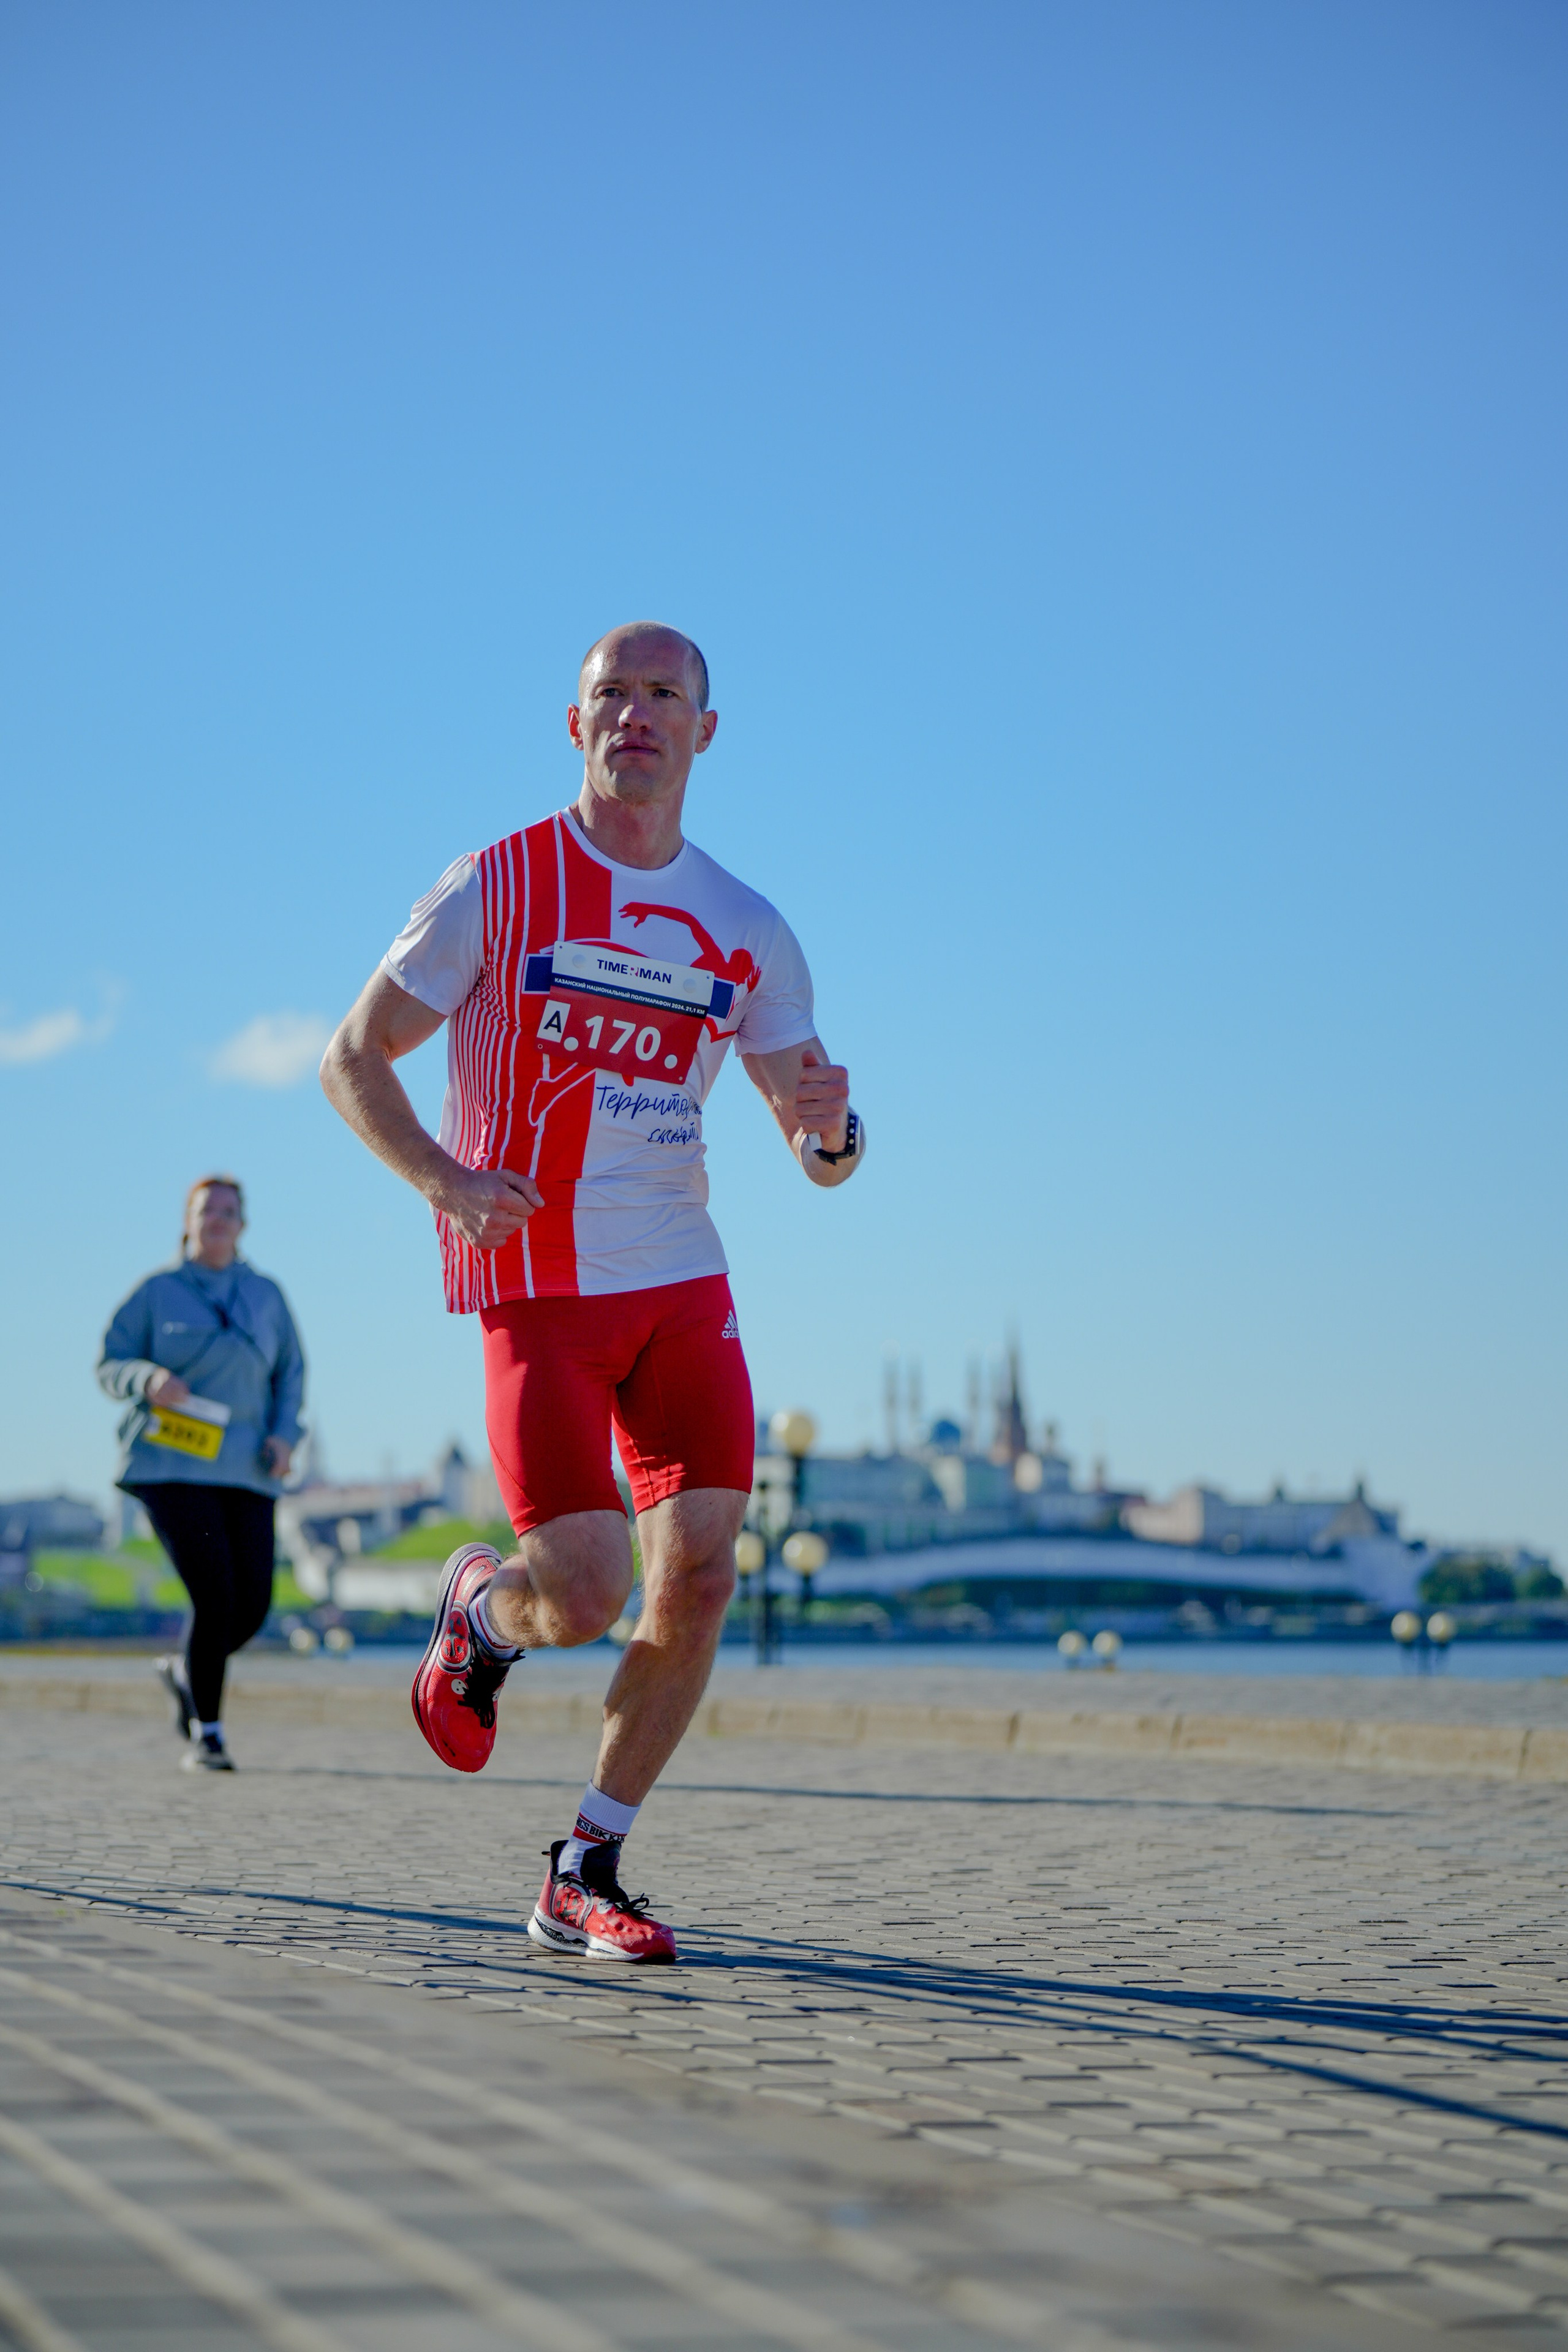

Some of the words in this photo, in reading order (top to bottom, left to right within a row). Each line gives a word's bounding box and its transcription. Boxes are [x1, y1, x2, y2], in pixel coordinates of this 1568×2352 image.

[554, 978, 586, 989] КАЗАНСКИЙ
[586, 984, 630, 998] НАЦИОНАЛЬНЫЙ
[631, 994, 671, 1007] ПОЛУМАРАФОН
[543, 1010, 562, 1033] A
[585, 1015, 661, 1061] 170
